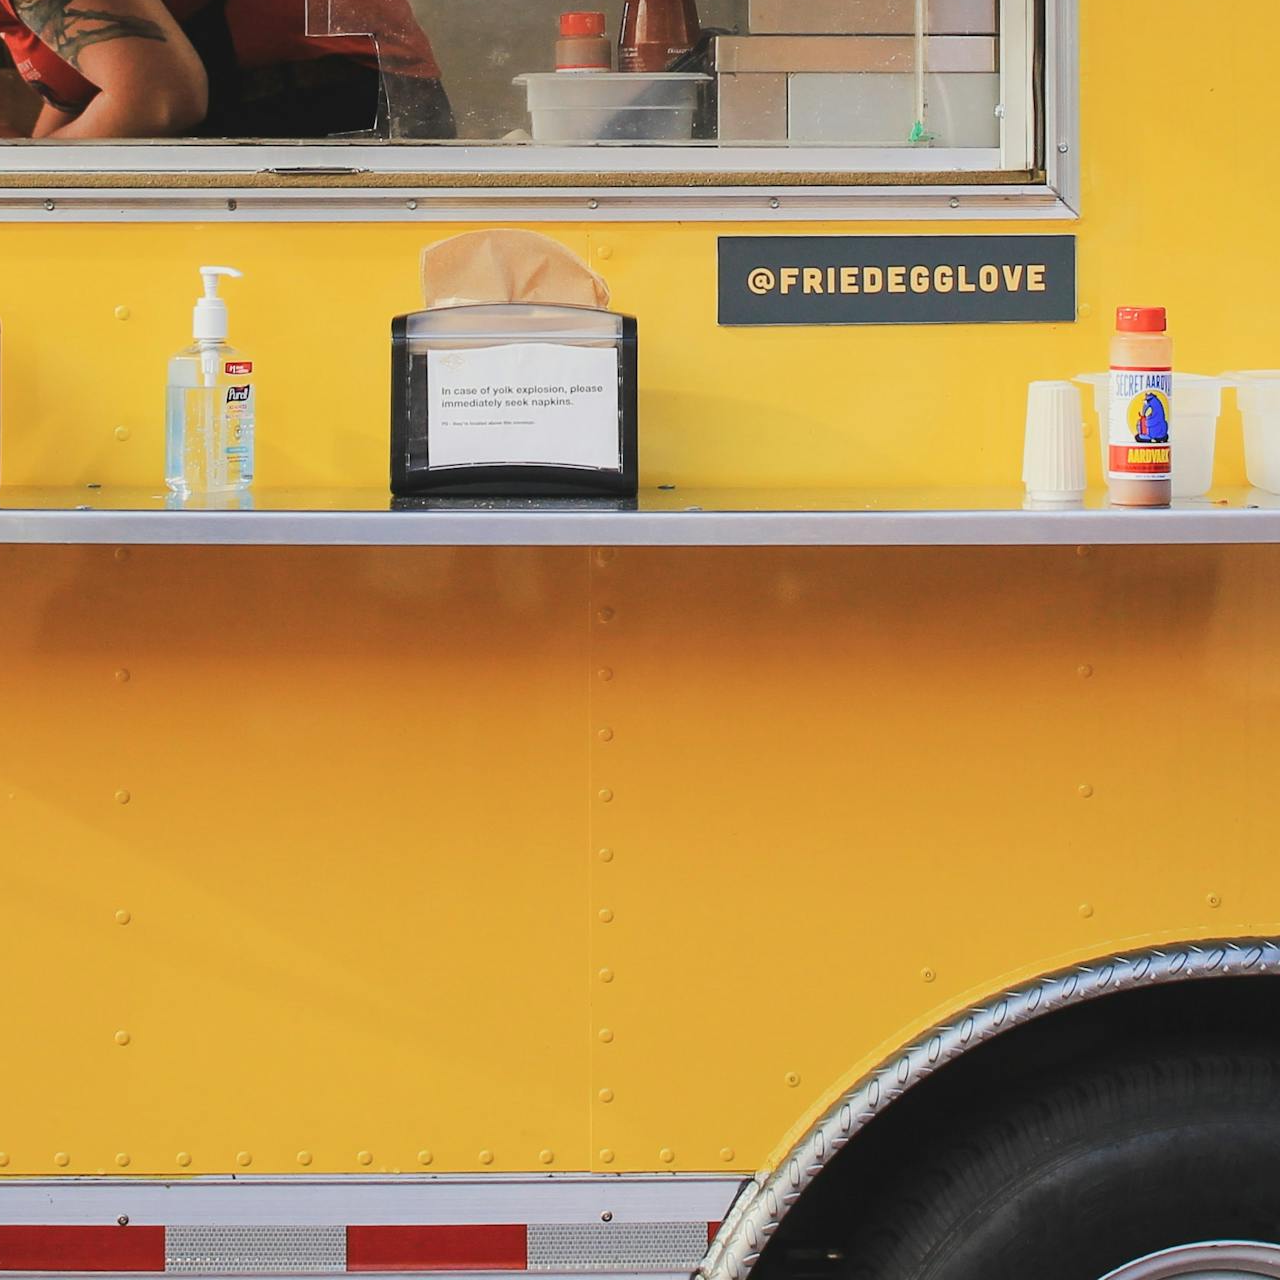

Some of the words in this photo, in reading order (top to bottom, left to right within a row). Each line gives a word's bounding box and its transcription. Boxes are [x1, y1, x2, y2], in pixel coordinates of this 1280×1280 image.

[747, 264, 1047, 295] @FRIEDEGGLOVE
[441, 387, 451, 396] In
[454, 387, 478, 396] case
[480, 386, 490, 395] of
[493, 385, 514, 396] yolk
[516, 384, 568, 396] explosion,
[570, 383, 603, 394] please
[1115, 374, 1144, 397] SECRET
[441, 397, 502, 409] immediately
[505, 397, 528, 407] seek
[531, 397, 574, 408] napkins.
